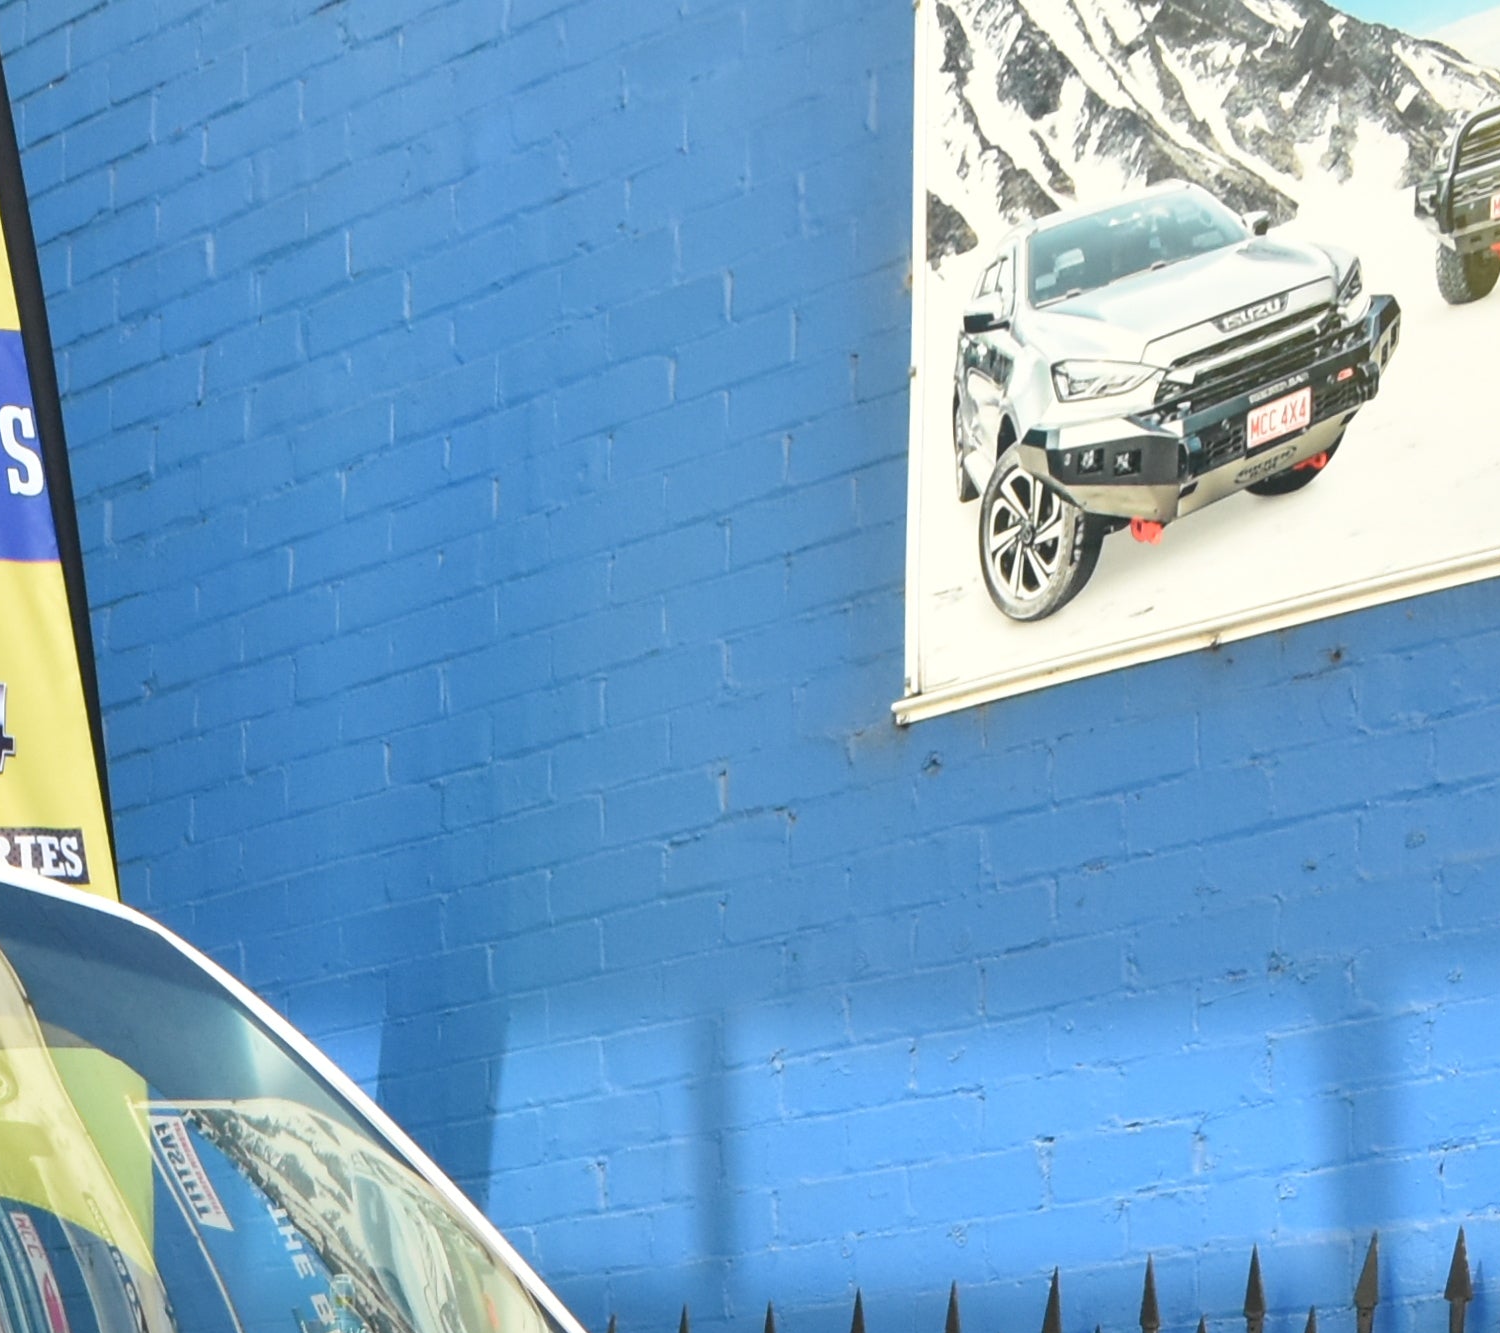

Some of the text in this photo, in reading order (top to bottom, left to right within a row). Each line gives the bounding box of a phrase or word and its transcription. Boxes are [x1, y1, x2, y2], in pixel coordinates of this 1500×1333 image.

[1222, 299, 1282, 331] ISUZU
[1250, 397, 1307, 439] MCC 4X4
